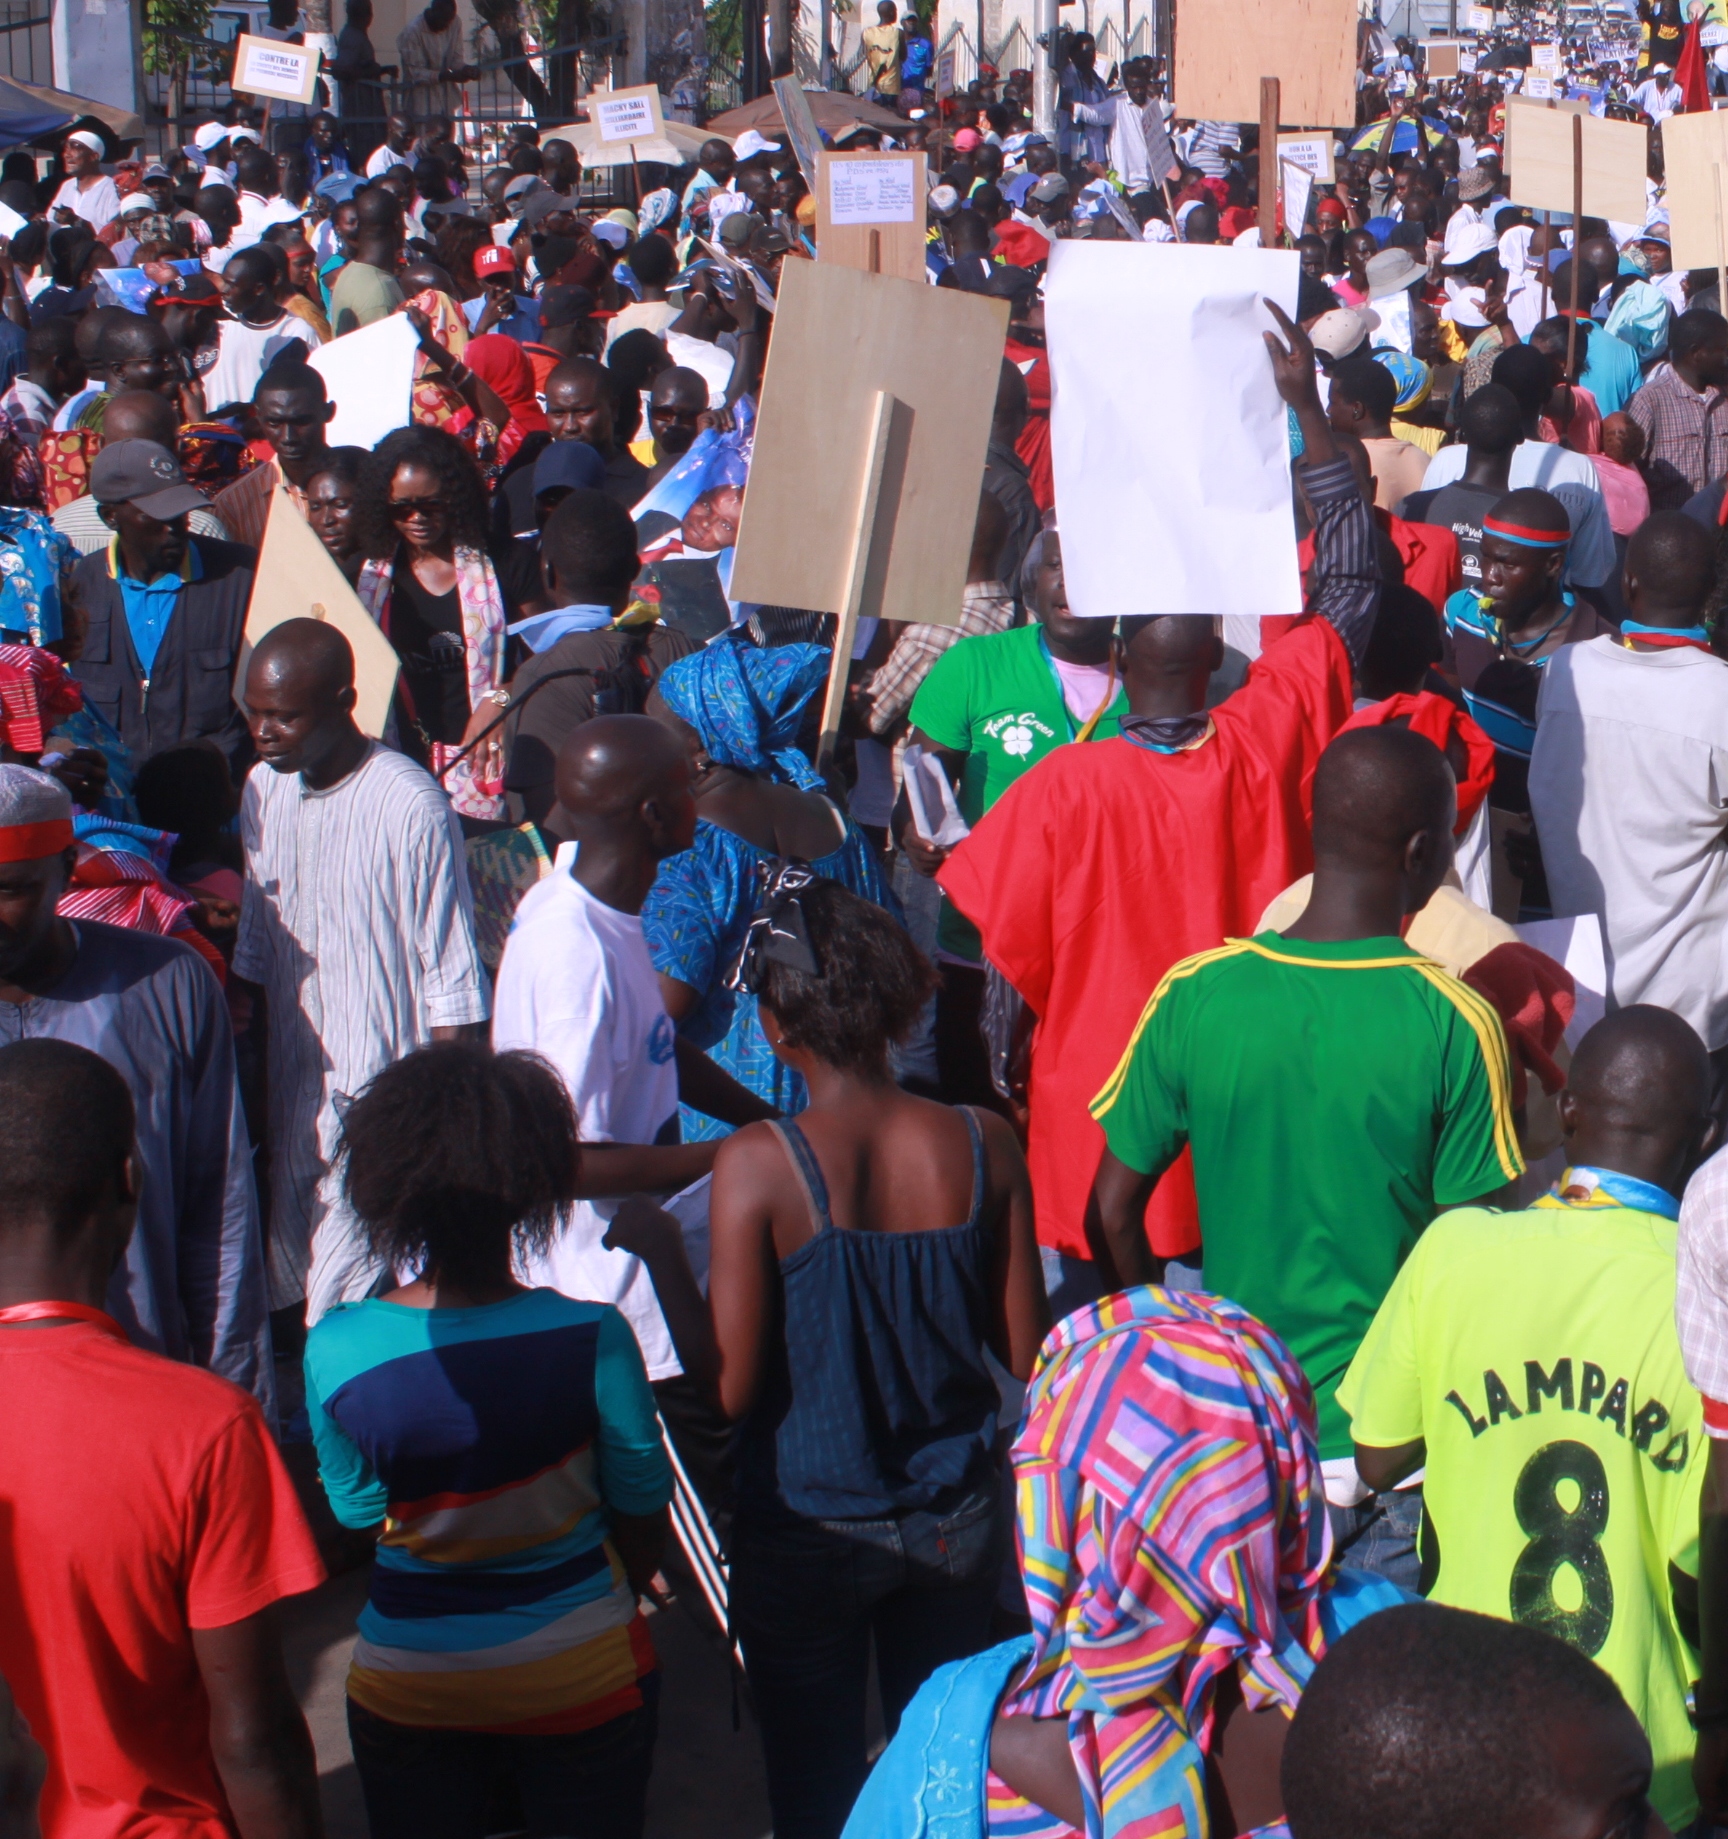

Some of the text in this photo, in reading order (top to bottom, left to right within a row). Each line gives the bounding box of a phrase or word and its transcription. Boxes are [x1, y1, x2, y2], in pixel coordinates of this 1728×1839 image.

[481, 248, 498, 265] rfi
[983, 712, 1055, 738] Team Green
[1443, 1357, 1689, 1475] LAMPARD
[1508, 1439, 1614, 1660] 8
